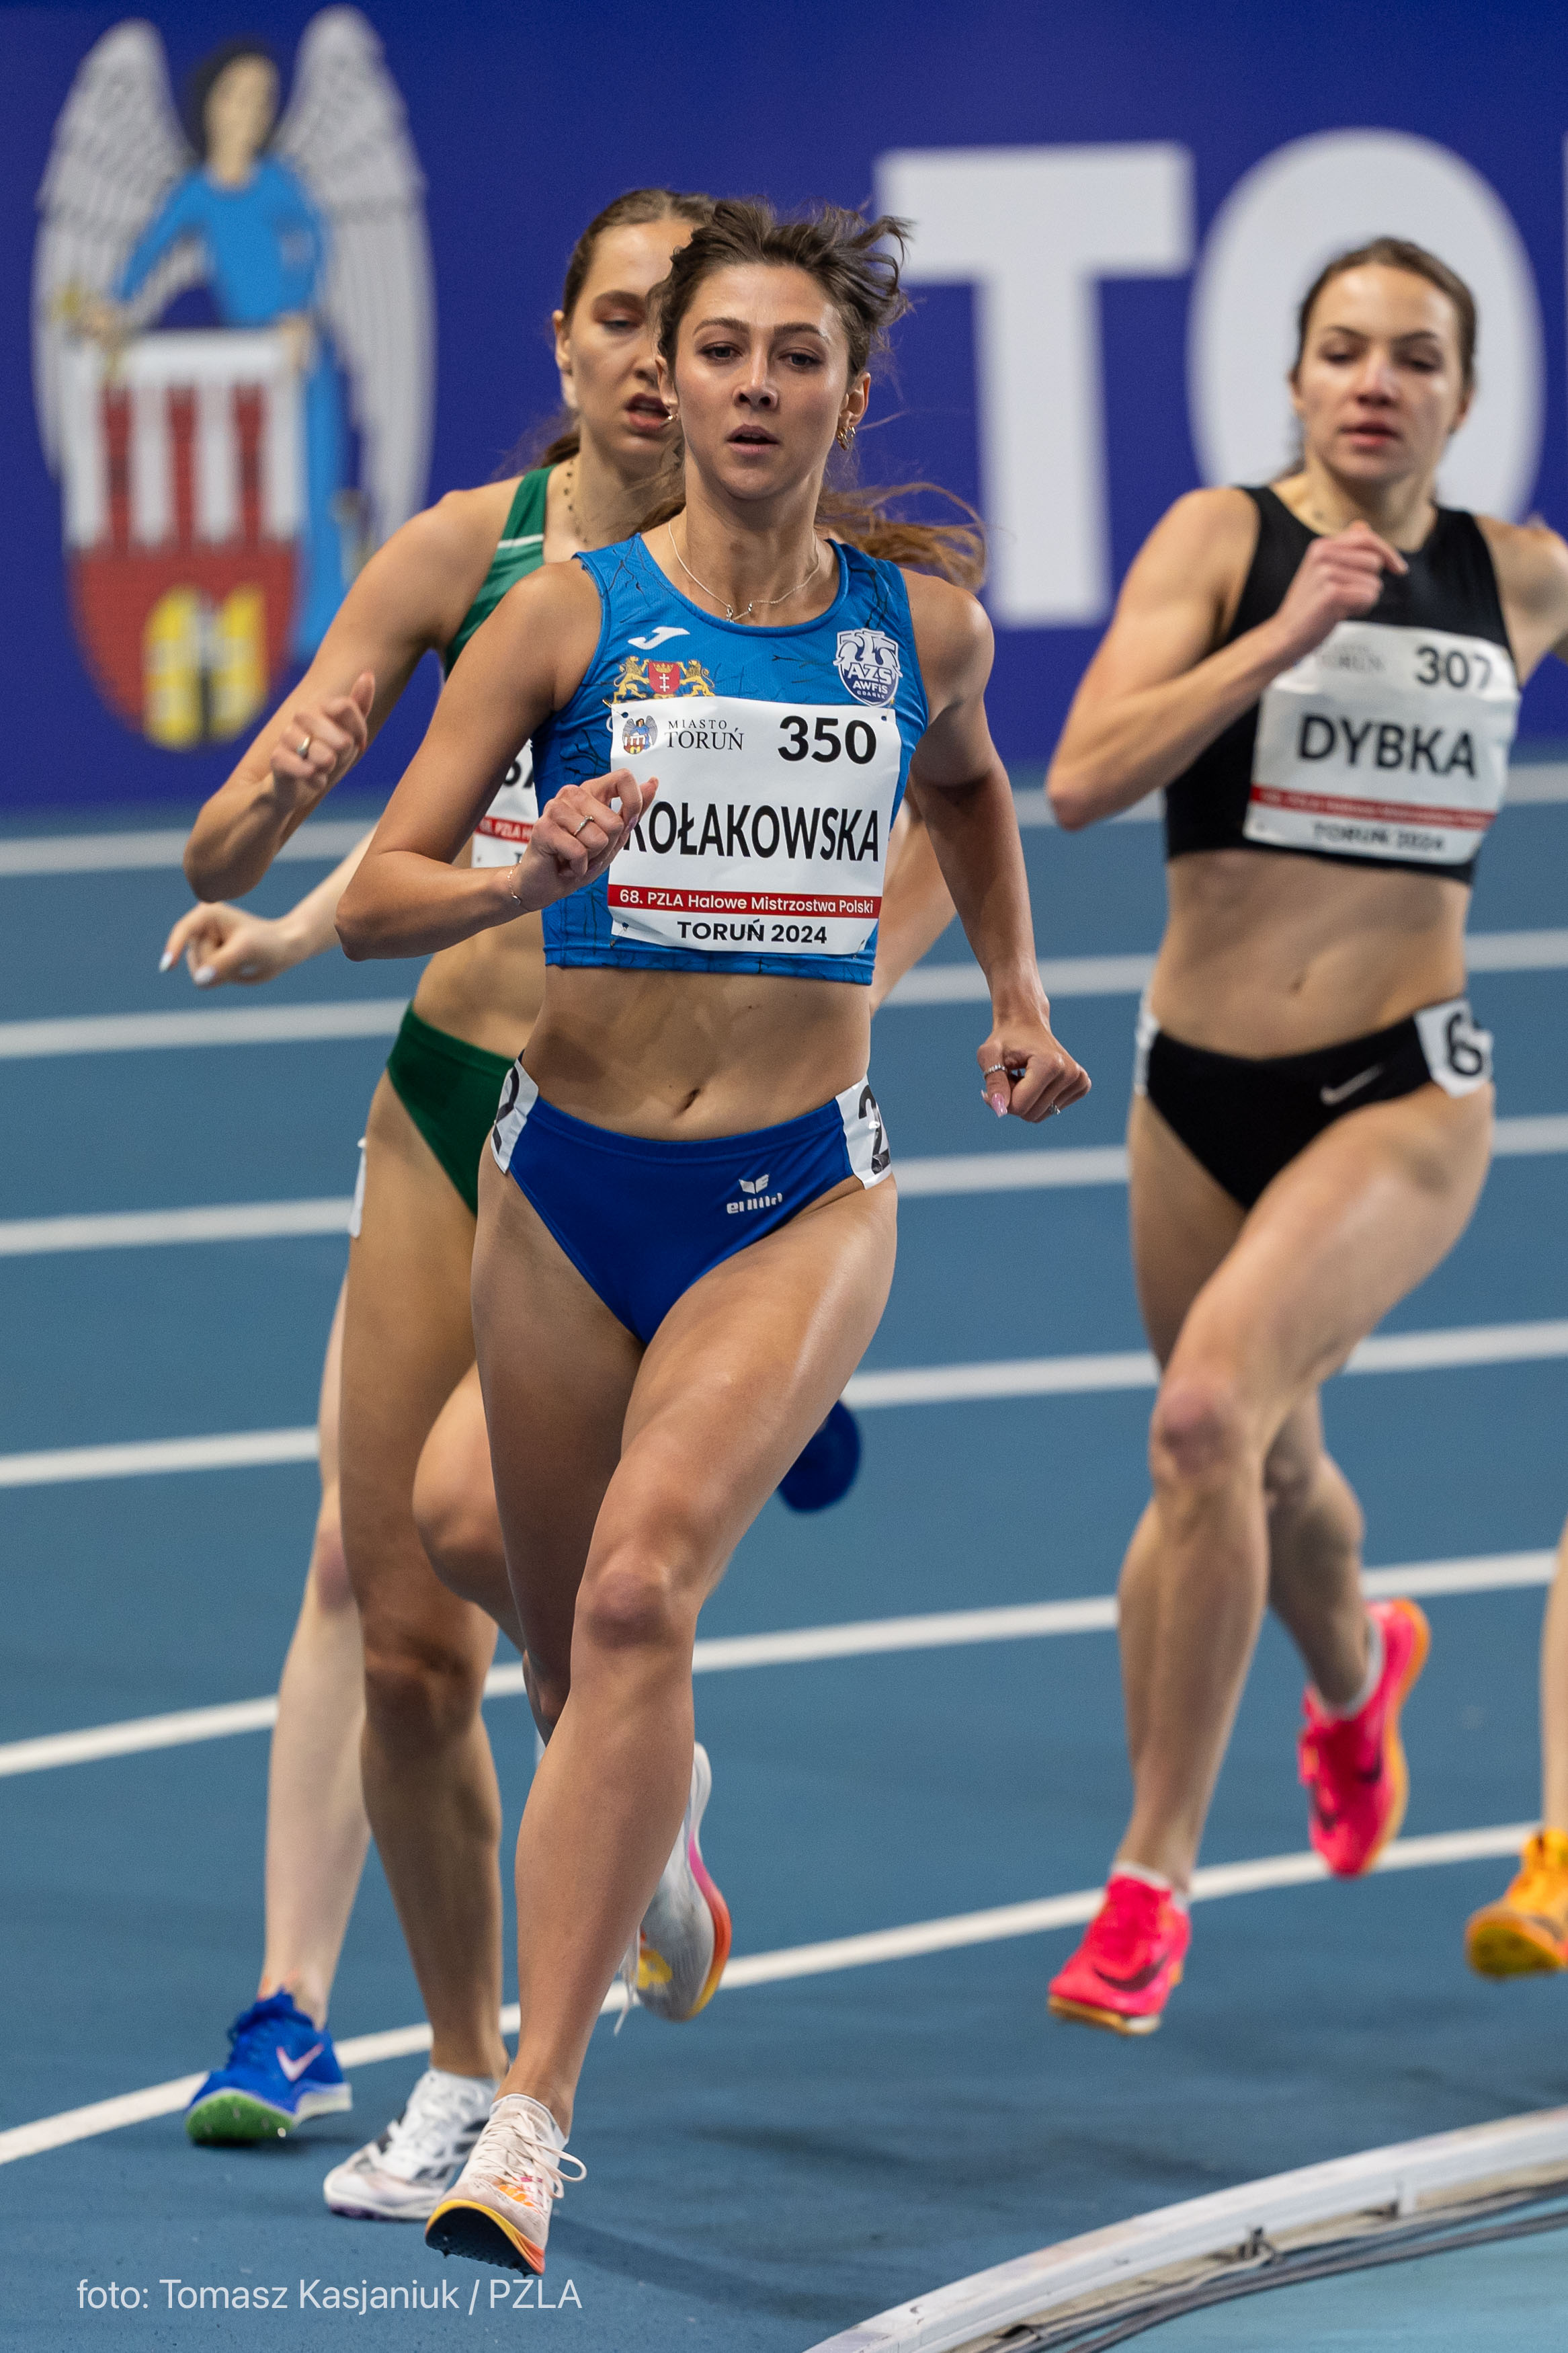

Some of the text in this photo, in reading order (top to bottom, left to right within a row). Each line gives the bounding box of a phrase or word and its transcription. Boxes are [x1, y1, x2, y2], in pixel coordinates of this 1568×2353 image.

[876, 125, 1568, 628] TO
[848, 662, 893, 685] AZS
[1416, 645, 1492, 689] 307
[664, 727, 745, 751] TORUŃ
[668, 719, 728, 730] MIASTO
[777, 715, 877, 765] 350
[1298, 714, 1476, 779] DYBKA
[619, 889, 874, 914] 68. PZLA Halowe Mistrzostwa Polski
[677, 918, 827, 944] TORUŃ 2024
[1446, 1011, 1485, 1077] 6
[858, 1084, 891, 1175] 2
